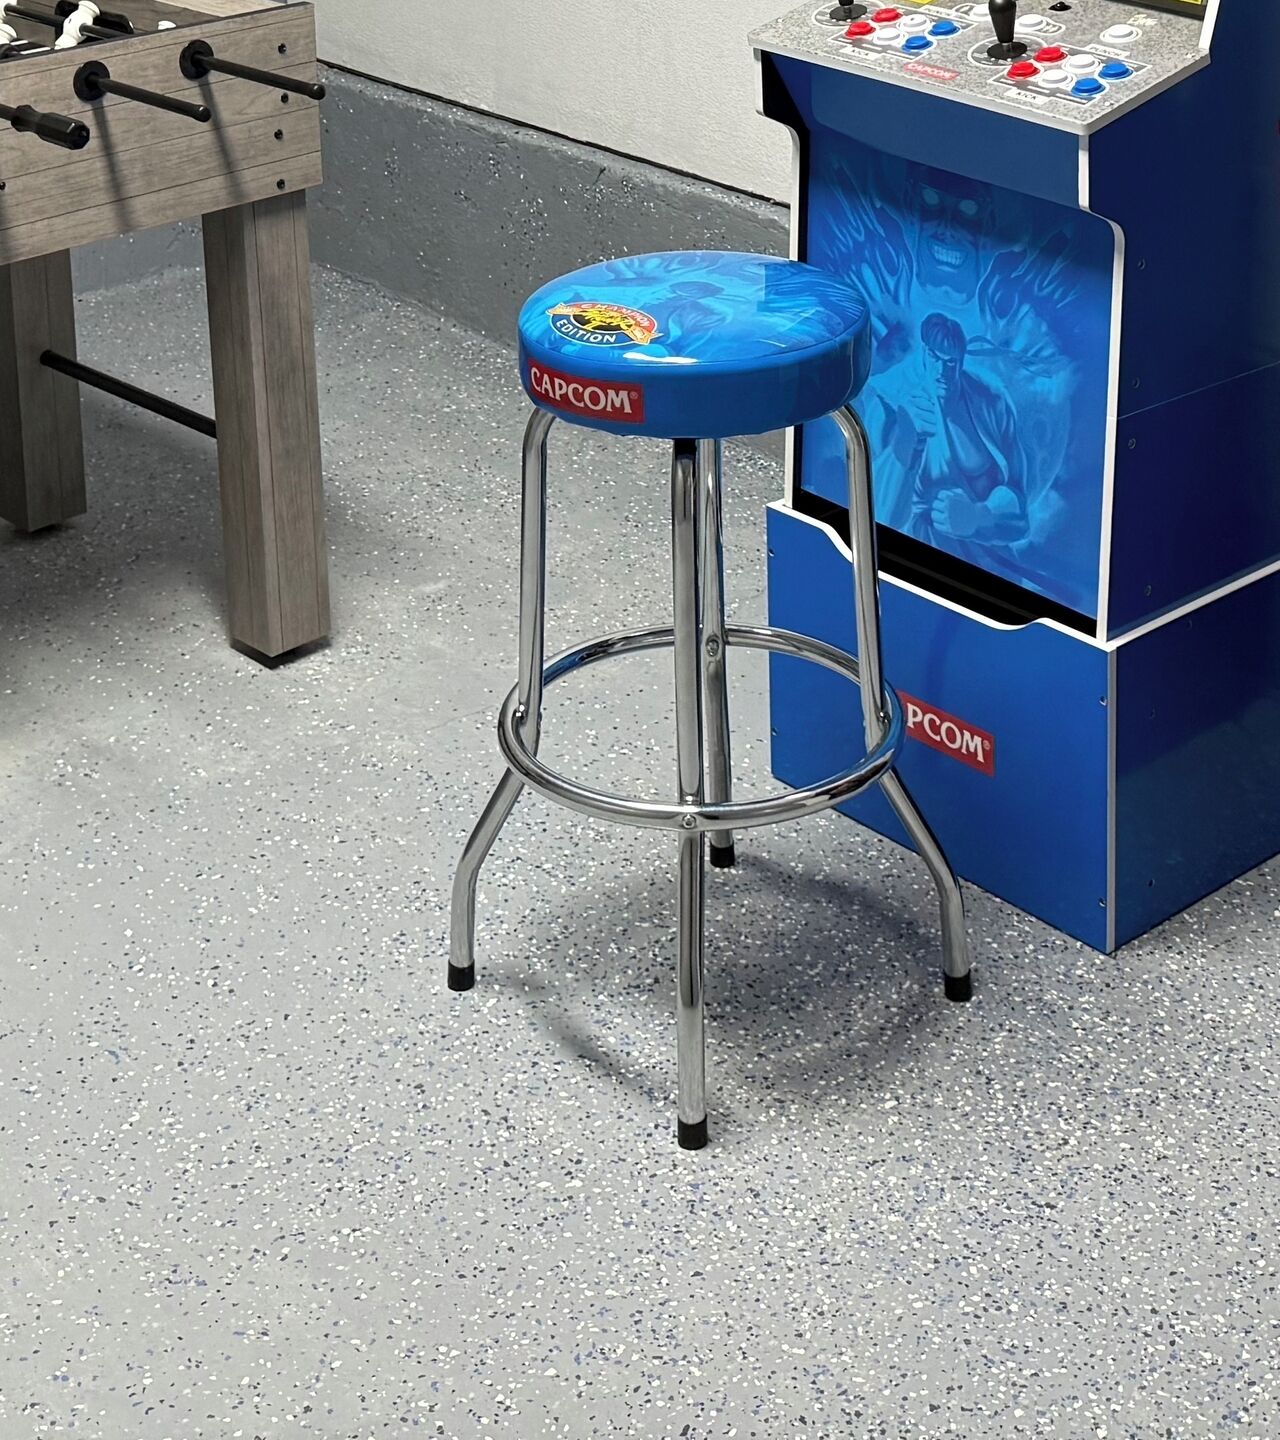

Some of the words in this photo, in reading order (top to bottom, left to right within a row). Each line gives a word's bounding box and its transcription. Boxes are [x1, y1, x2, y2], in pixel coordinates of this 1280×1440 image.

[908, 62, 953, 78] CAPCOM
[556, 318, 617, 343] EDITION
[530, 367, 632, 414] CAPCOM
[906, 702, 985, 763] PCOM
